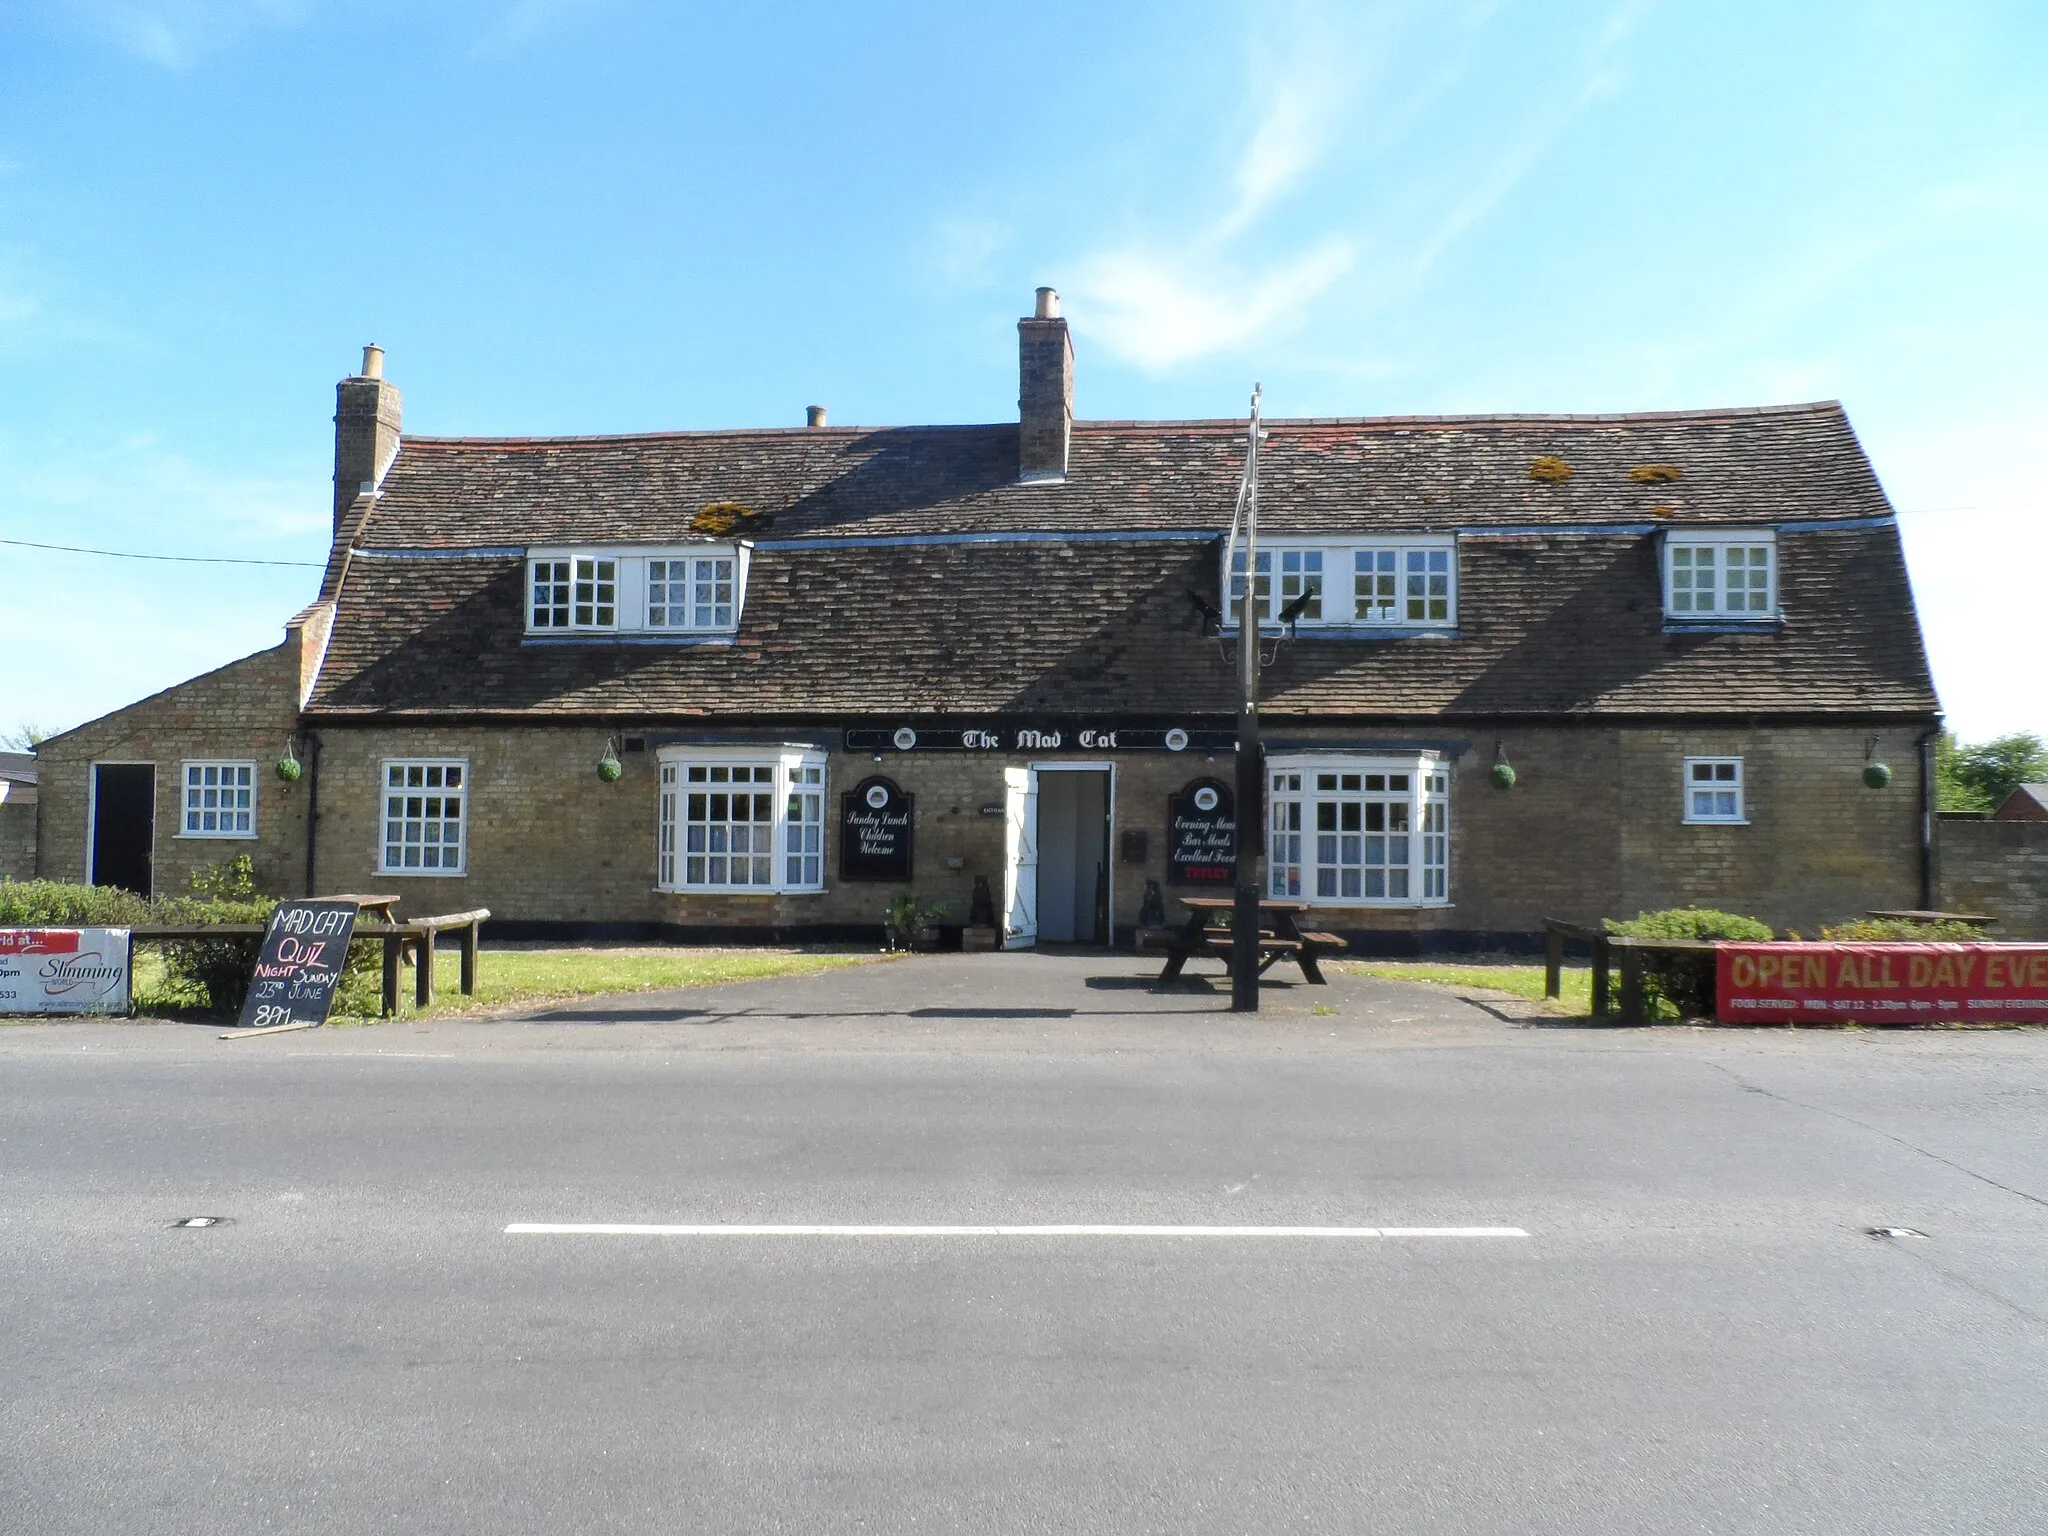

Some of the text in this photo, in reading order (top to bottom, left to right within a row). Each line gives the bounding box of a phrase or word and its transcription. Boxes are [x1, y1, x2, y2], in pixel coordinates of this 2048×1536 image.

[962, 729, 1117, 749] The Mad Cat
[847, 811, 908, 832] Sunday Lunch
[1175, 816, 1210, 834] Evening
[860, 827, 895, 841] Children
[1182, 832, 1231, 846] Bar Meals
[860, 841, 894, 855] Welcome
[1174, 848, 1214, 862] Excellent
[278, 937, 328, 968] QUIZ
[39, 958, 123, 987] Slimming
[254, 963, 338, 988] NIGHT SUNDAY
[1731, 955, 1827, 988] OPEN
[1836, 955, 1899, 988] ALL
[1909, 956, 1977, 988] DAY
[288, 983, 322, 999] JUNE
[1731, 999, 1757, 1009] FOOD
[1758, 999, 1799, 1009] SERVED:
[254, 1005, 291, 1026] 8PM
